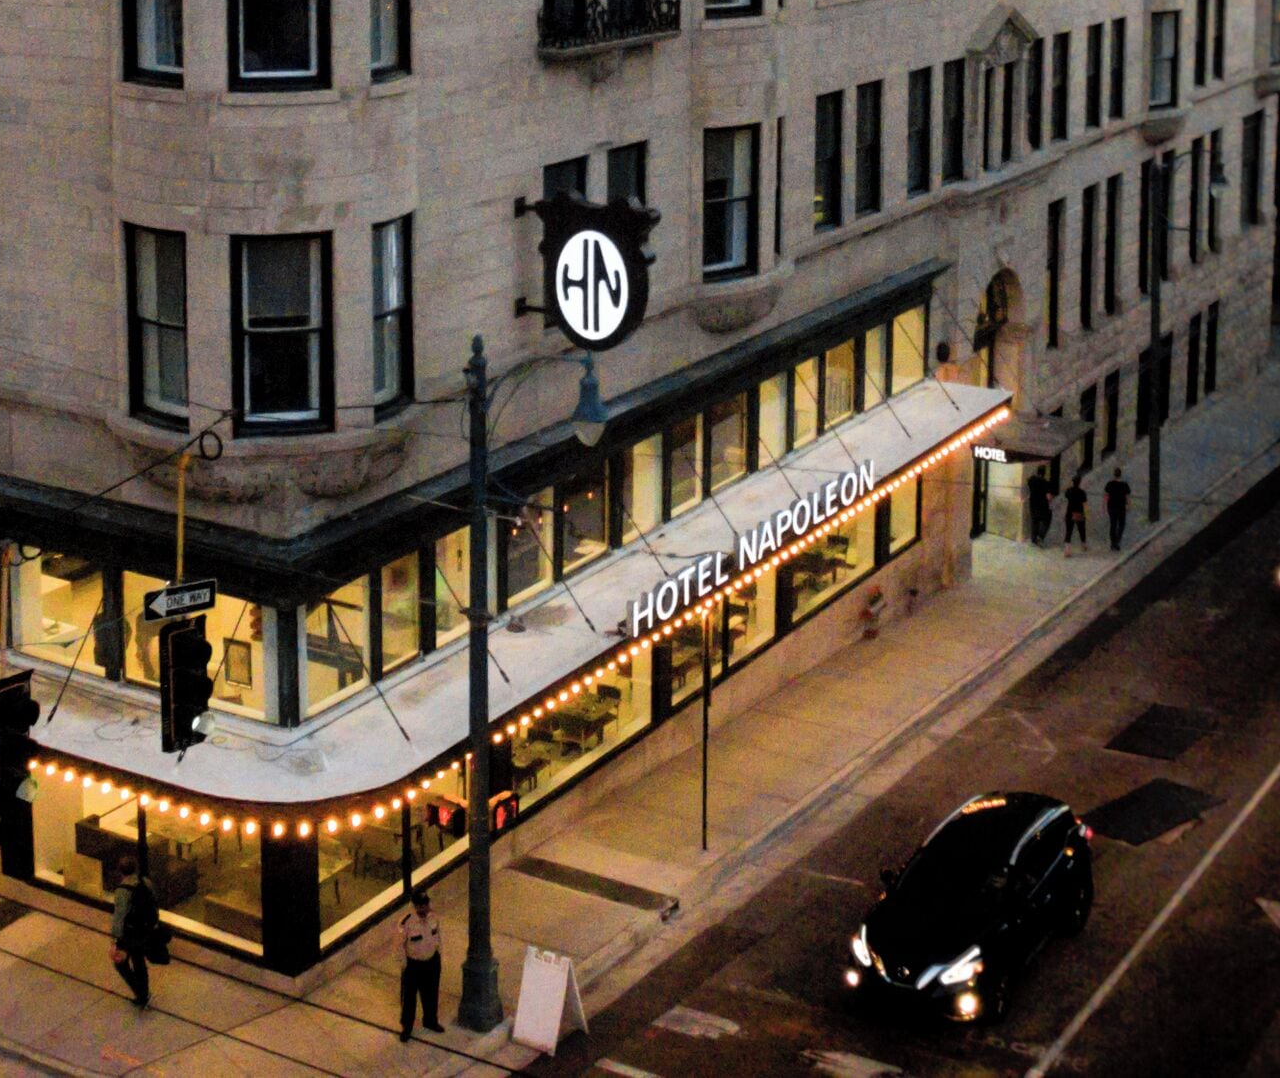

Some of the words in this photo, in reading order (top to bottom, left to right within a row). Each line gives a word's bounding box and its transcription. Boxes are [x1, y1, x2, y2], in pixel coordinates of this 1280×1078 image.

[562, 238, 621, 333] HN
[974, 445, 1007, 462] HOTEL
[632, 550, 729, 638] HOTEL
[737, 459, 875, 571] NAPOLEON
[166, 593, 186, 609] ONE
[189, 589, 209, 603] WAY
